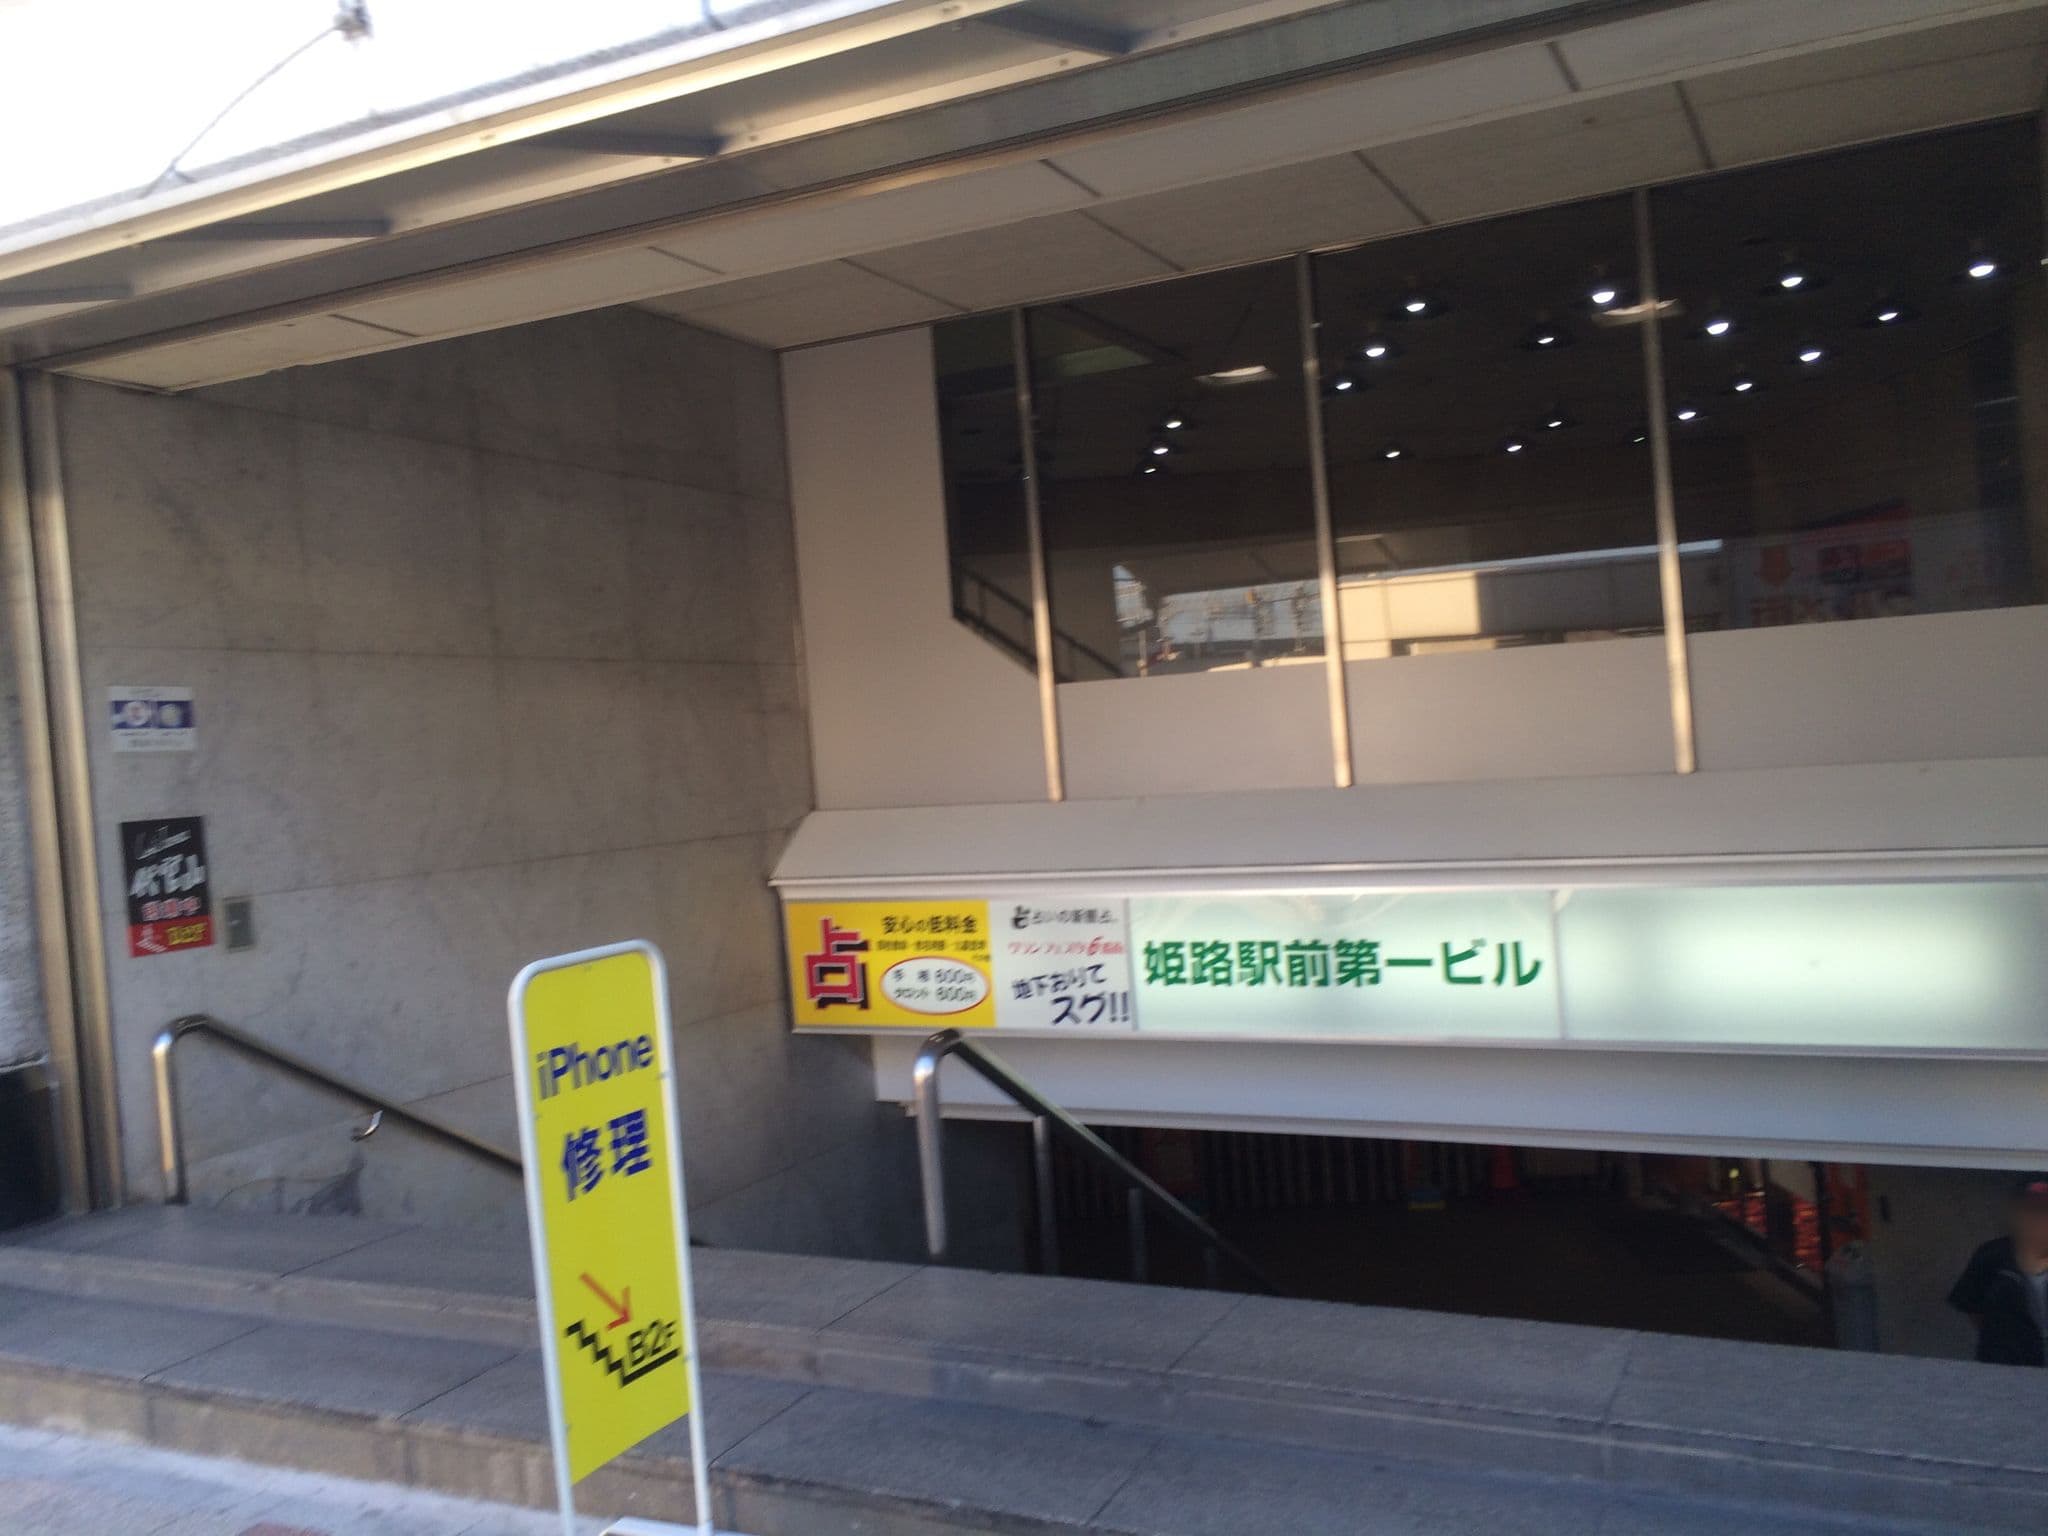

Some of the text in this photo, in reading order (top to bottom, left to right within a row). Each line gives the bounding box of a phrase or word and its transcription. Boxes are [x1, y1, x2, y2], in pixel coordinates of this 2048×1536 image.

[882, 914, 978, 934] 安心の低料金
[805, 917, 869, 1009] 占
[1011, 963, 1108, 999] 地下おりて
[1143, 938, 1543, 987] 姫路駅前第一ビル
[536, 1032, 655, 1100] iPhone
[561, 1109, 655, 1203] 修理
[625, 1318, 680, 1369] B2F
